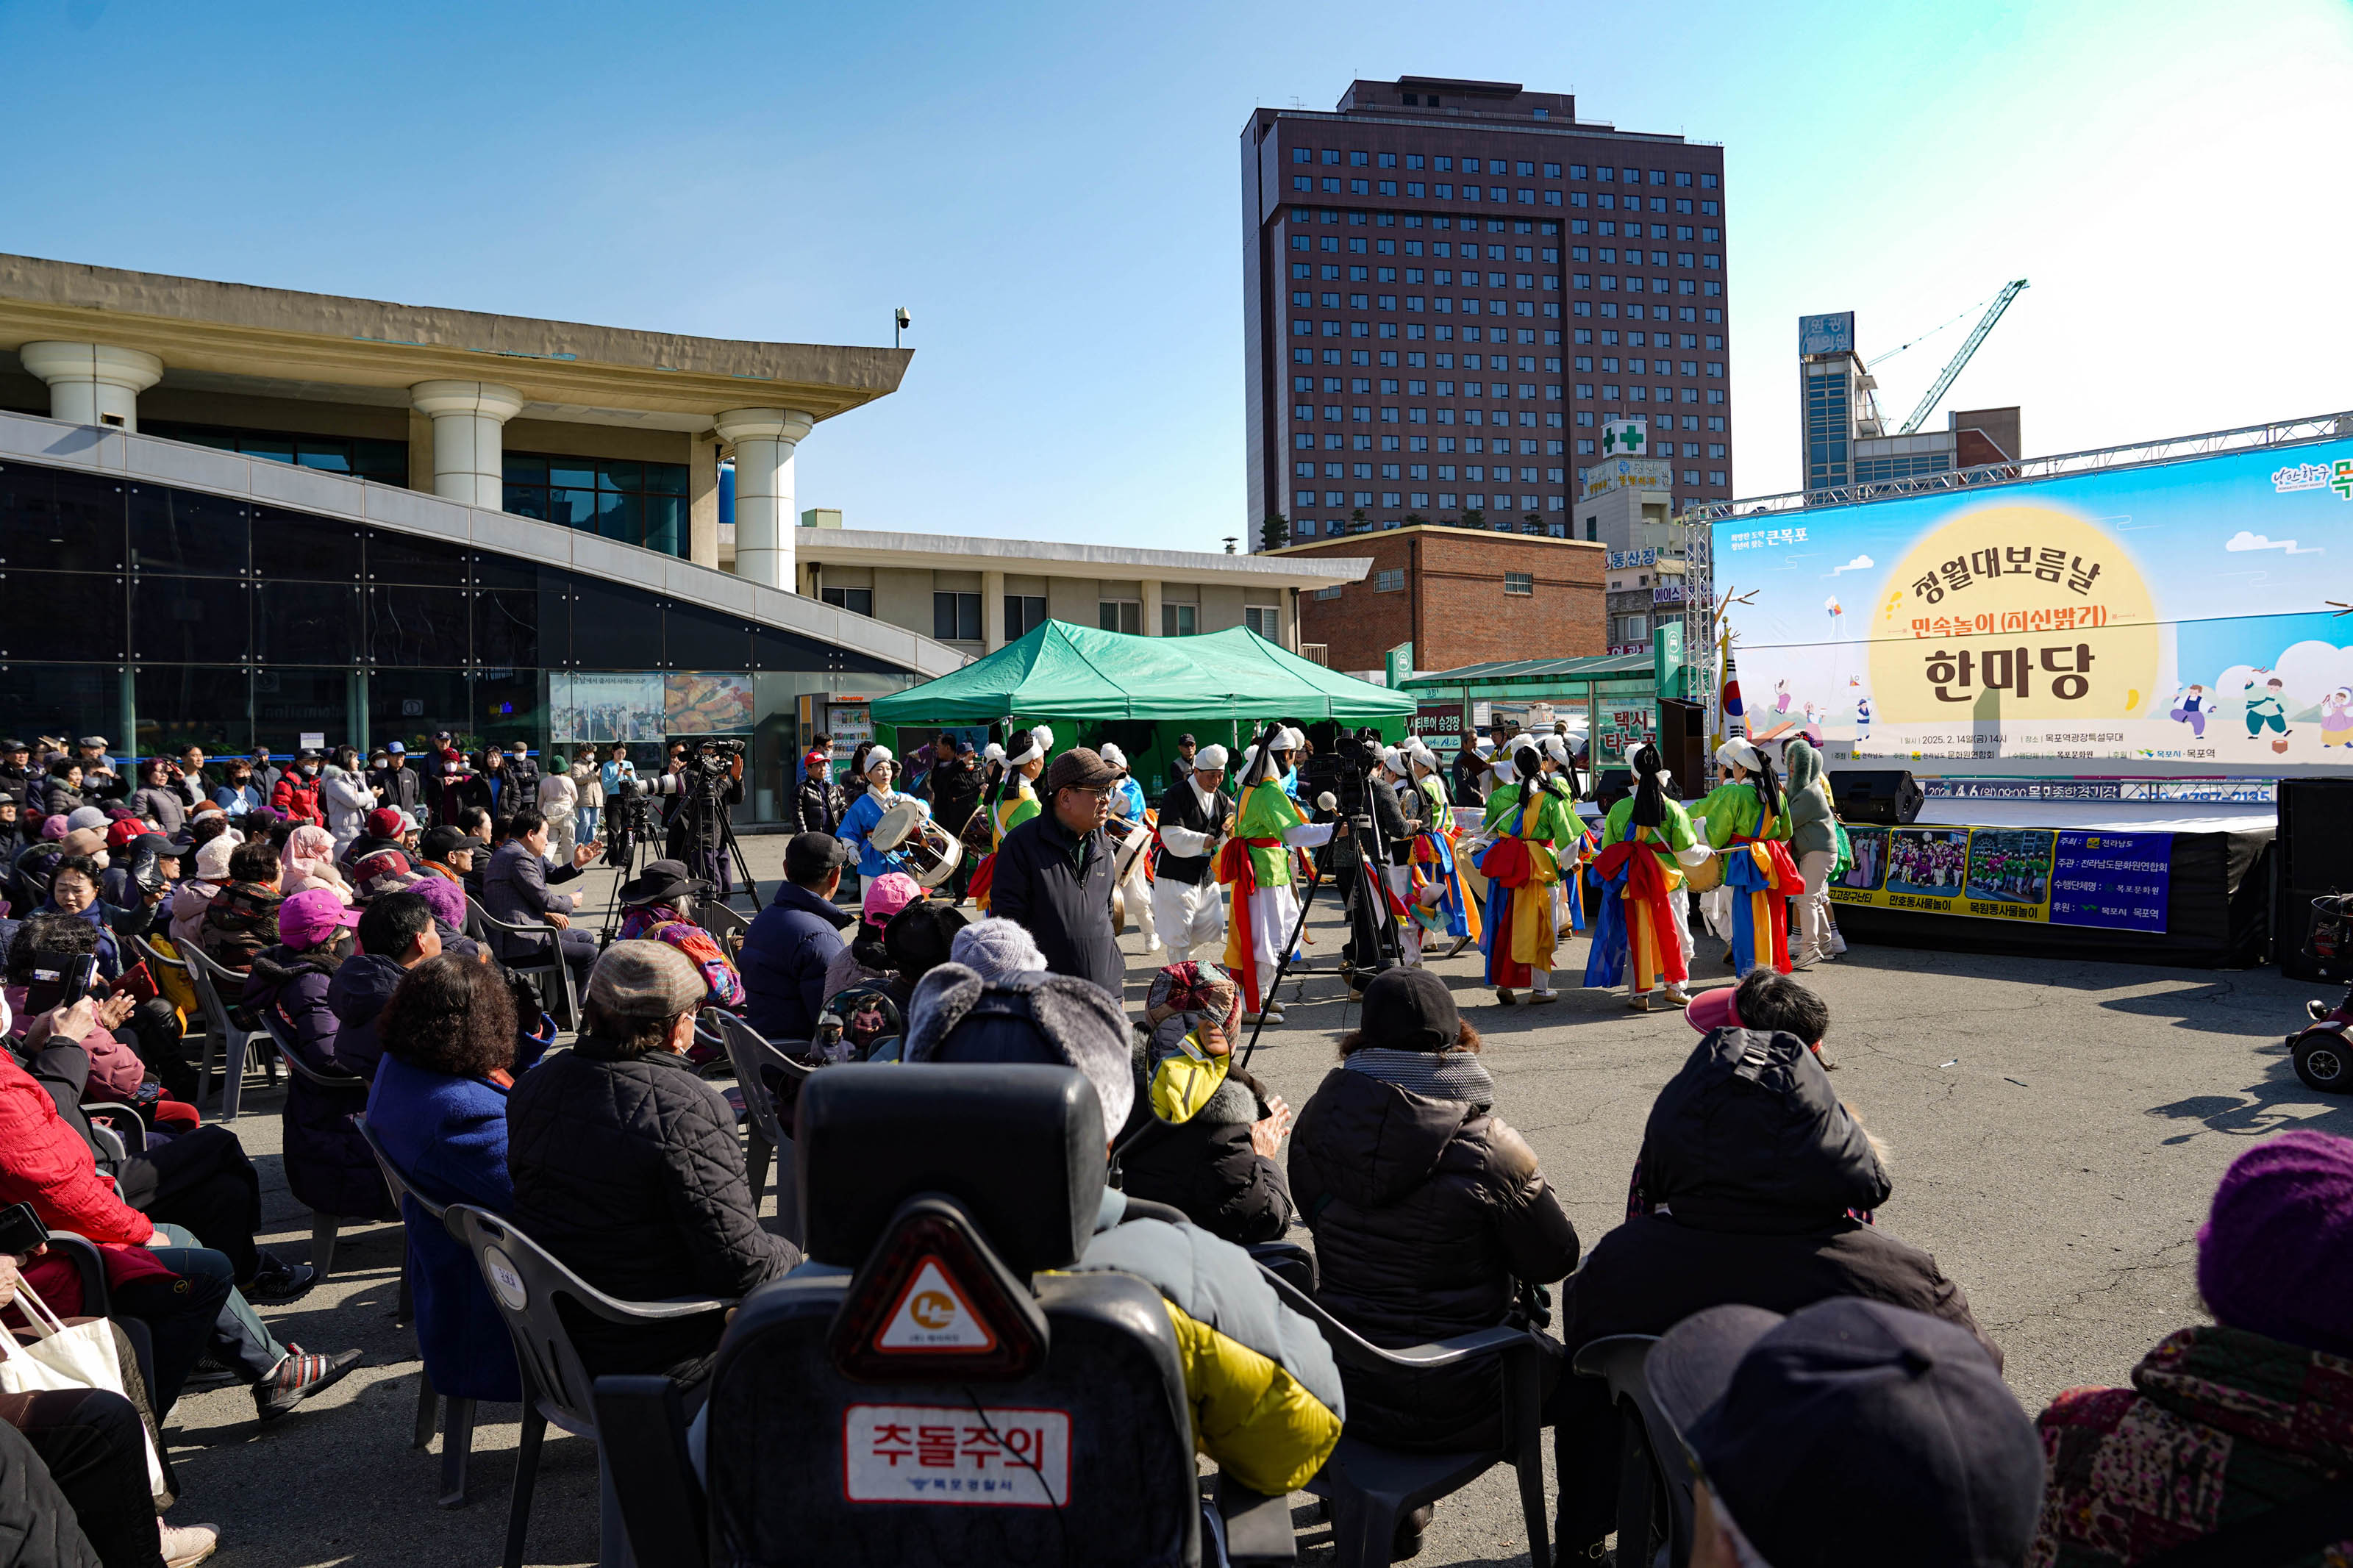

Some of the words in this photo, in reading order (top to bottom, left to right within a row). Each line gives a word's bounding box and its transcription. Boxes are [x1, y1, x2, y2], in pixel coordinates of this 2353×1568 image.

[1765, 527, 1809, 546] 큰목포
[1613, 548, 1655, 569] 동산장
[1912, 546, 2101, 604] 정월대보름날
[1654, 587, 1679, 602] 에이스
[1911, 613, 1994, 639] 민속놀이
[1668, 654, 1679, 663] TAXI
[1924, 643, 2096, 703] 한마당
[1438, 715, 1460, 731] 승강장
[1613, 710, 1647, 731] 택시
[1922, 736, 1945, 745] 2025.
[1957, 734, 1988, 744] 14일(금)
[1990, 734, 2007, 742] 14시
[2045, 733, 2124, 742] 목포역광장특설무대
[1948, 751, 1994, 759] 문화원연합회
[2057, 751, 2093, 759] 목포문화원
[2157, 750, 2181, 758] 목포시
[2187, 749, 2215, 758] 목포역
[2060, 837, 2077, 846] 주최
[2102, 839, 2133, 848] 전라남도
[2057, 859, 2075, 868] 주관
[2081, 859, 2168, 873] 전라남도문화원연합회
[2054, 880, 2096, 892] 수행단체명
[2116, 884, 2159, 895] 목포문화원
[1889, 895, 1951, 912] 만호동사물놀이
[1970, 902, 2038, 919] 목원동사물놀이
[2053, 902, 2070, 912] 후원
[2102, 907, 2127, 917] 목포시
[2133, 908, 2159, 920] 목포역
[872, 1424, 1043, 1472] 추돌주의
